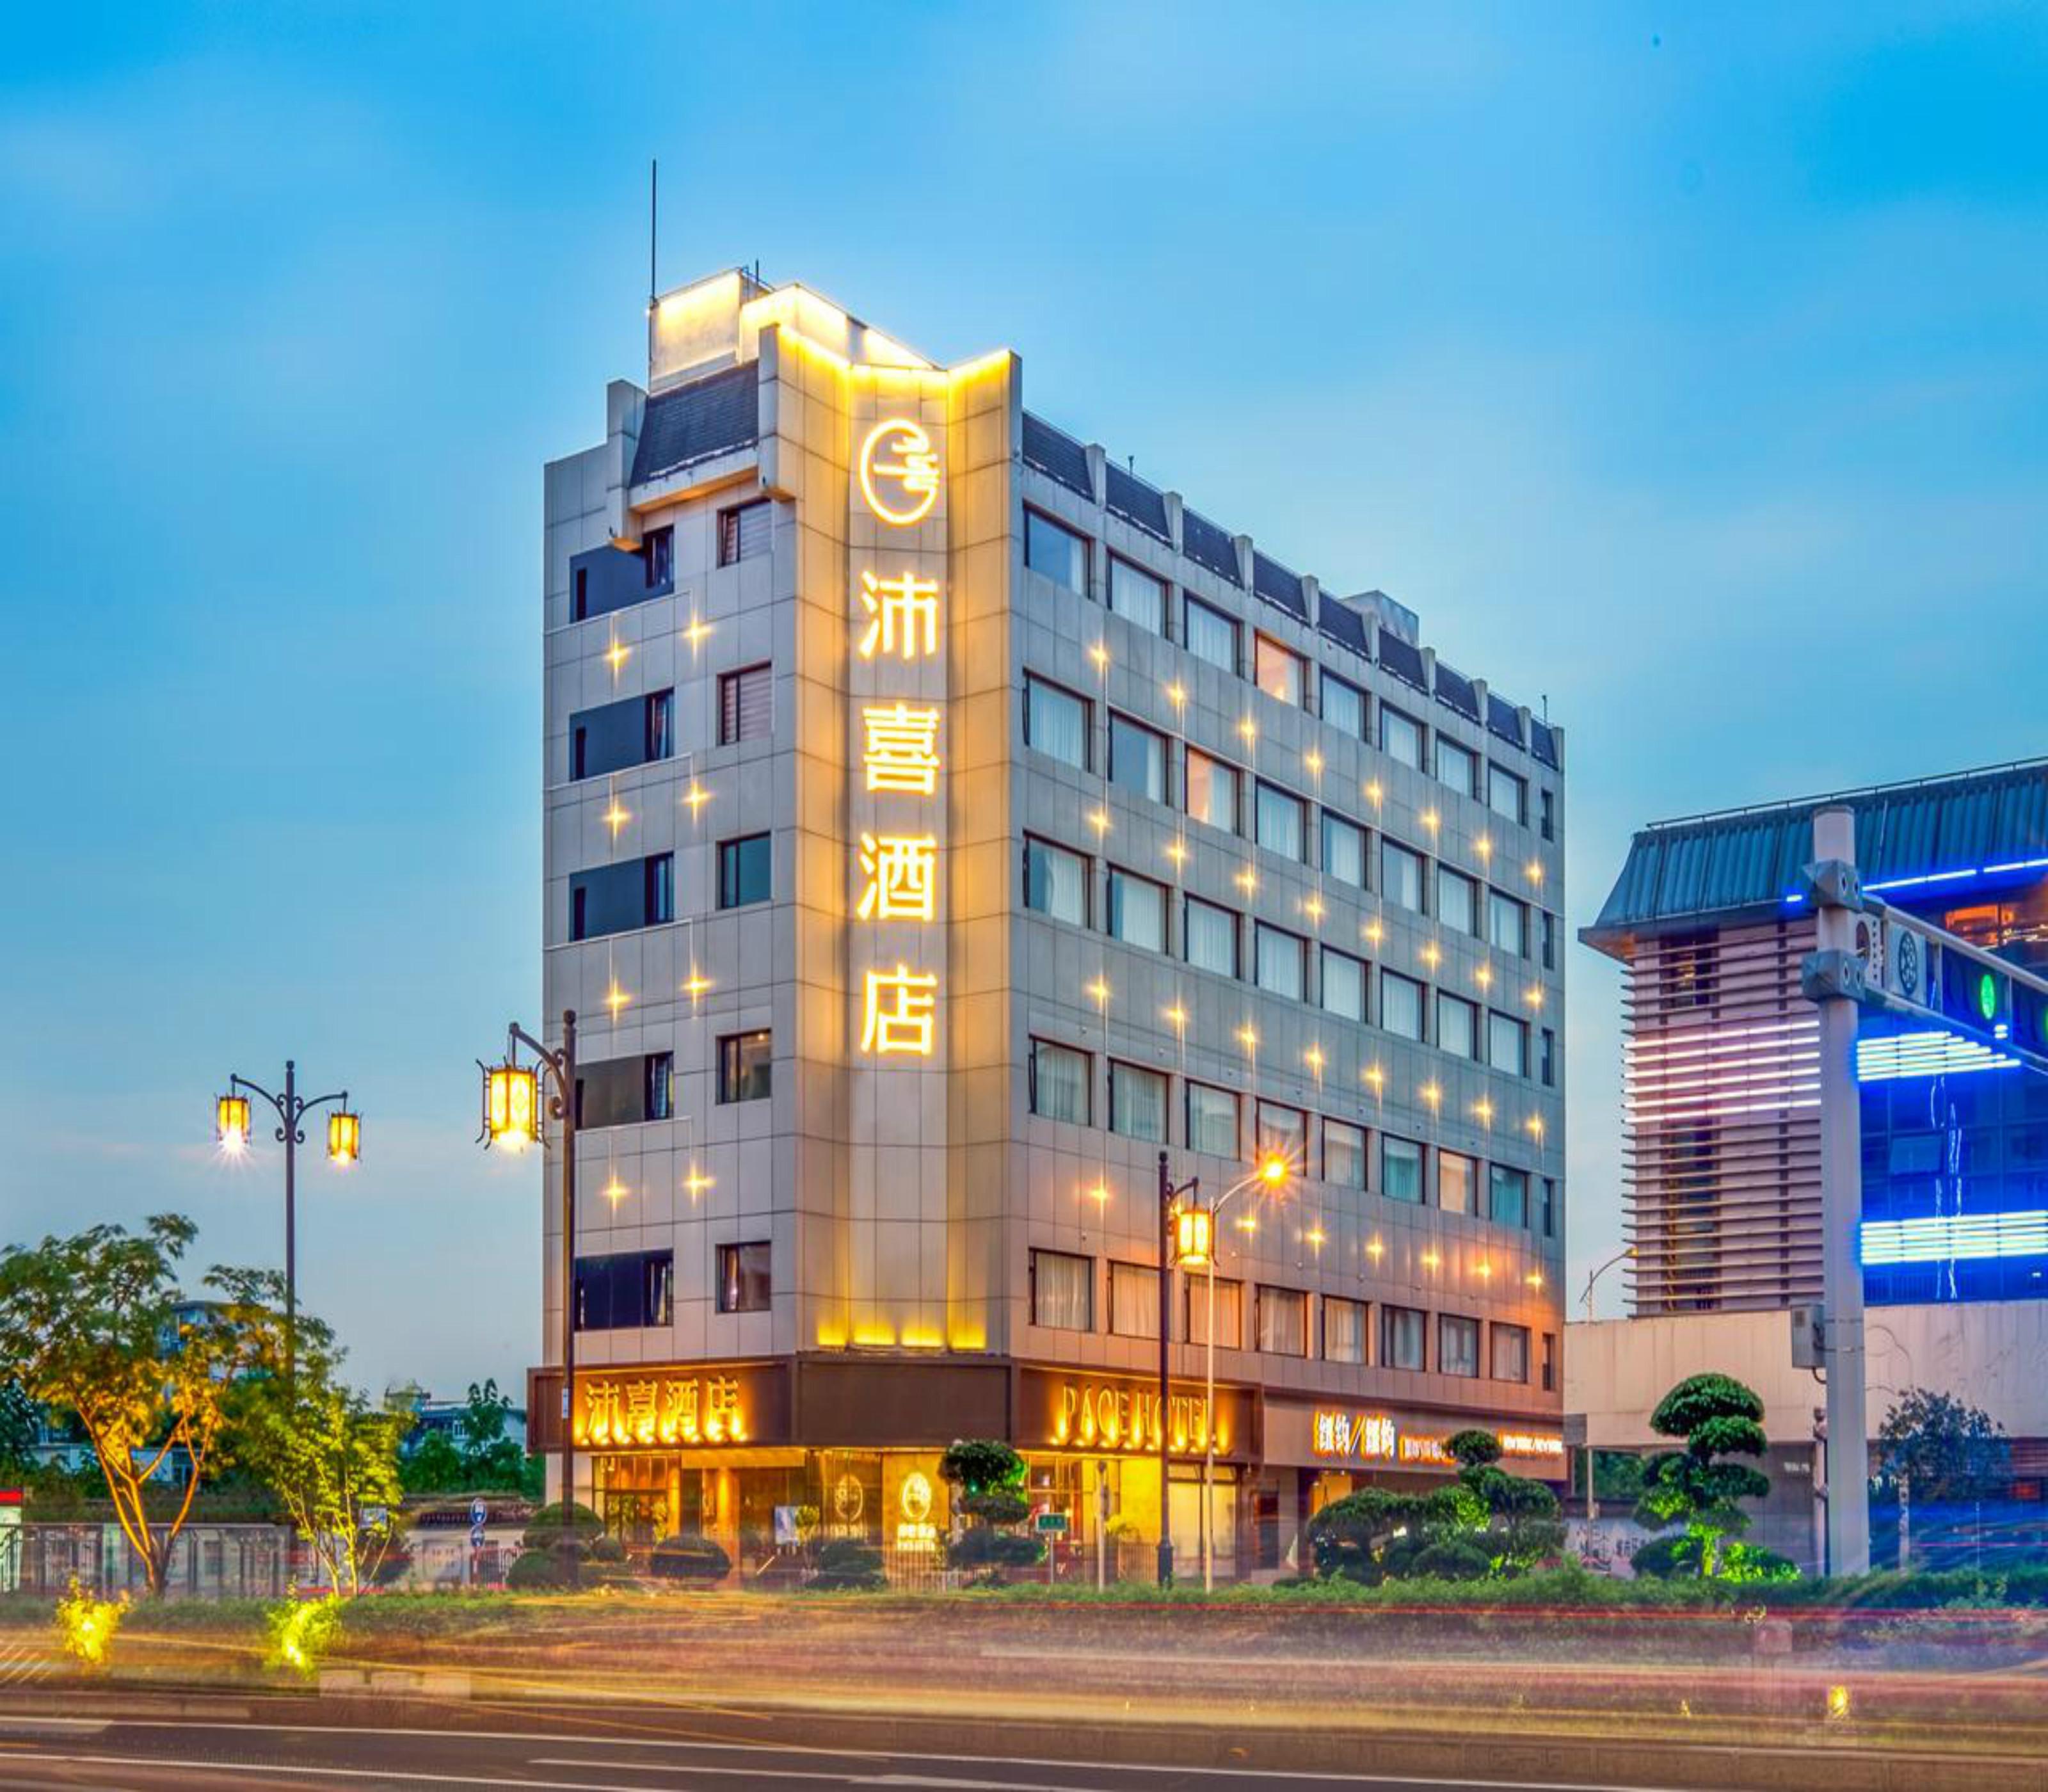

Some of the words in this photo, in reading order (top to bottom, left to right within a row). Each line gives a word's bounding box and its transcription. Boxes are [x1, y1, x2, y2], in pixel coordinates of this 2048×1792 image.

[858, 571, 940, 1055] 沛喜酒店
[585, 1376, 739, 1436] 沛喜酒店
[1062, 1384, 1130, 1436] PACE
